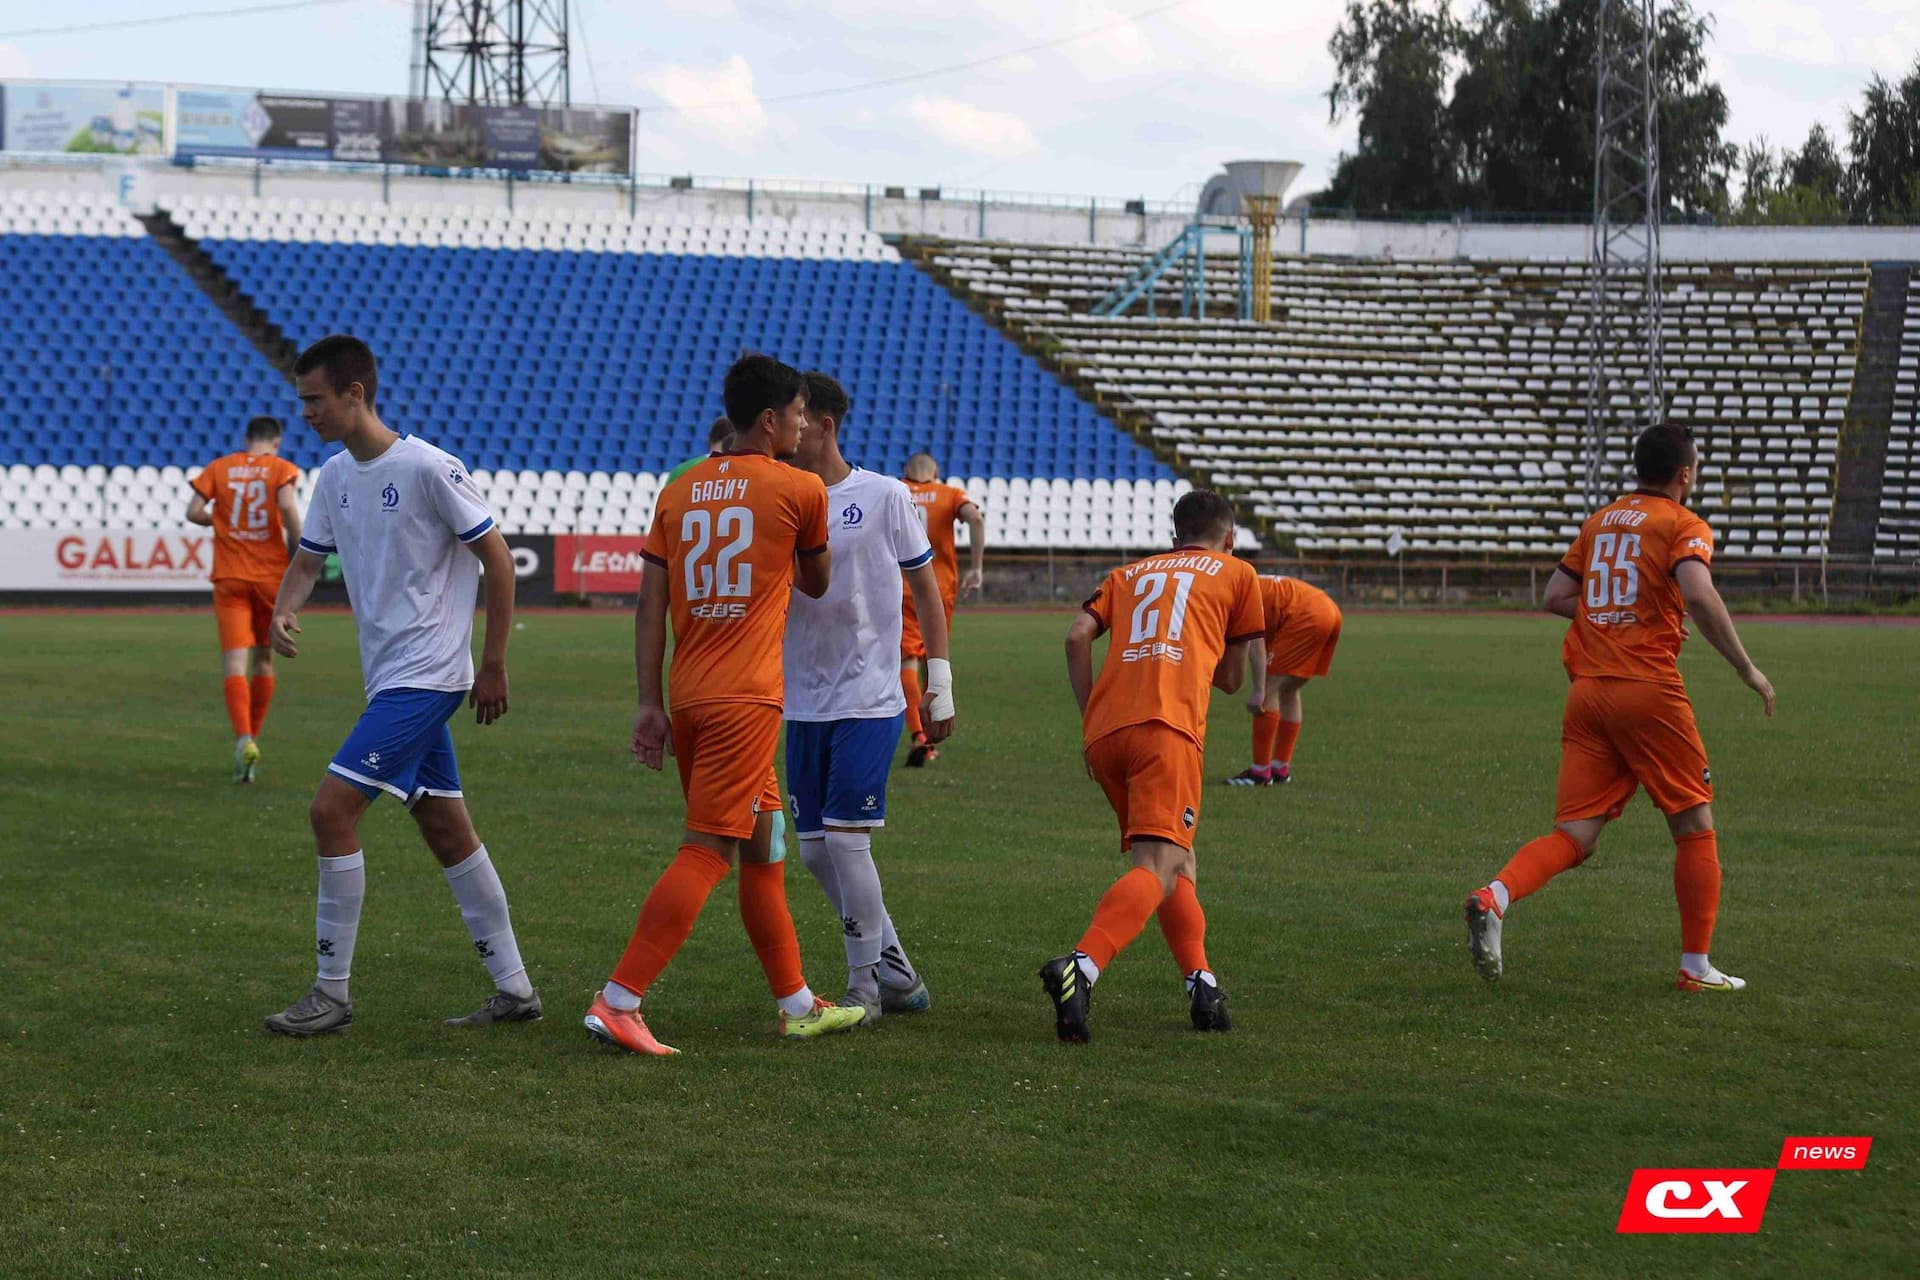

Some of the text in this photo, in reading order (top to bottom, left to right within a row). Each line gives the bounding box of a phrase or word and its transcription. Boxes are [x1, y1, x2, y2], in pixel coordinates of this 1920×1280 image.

[227, 480, 268, 528] 72
[691, 479, 749, 503] БАБИЧ
[57, 536, 214, 570] GALAX
[681, 506, 754, 600] 22
[1125, 556, 1224, 581] КРУГЛЯКОВ
[1587, 533, 1641, 608] 55
[1129, 572, 1195, 644] 21
